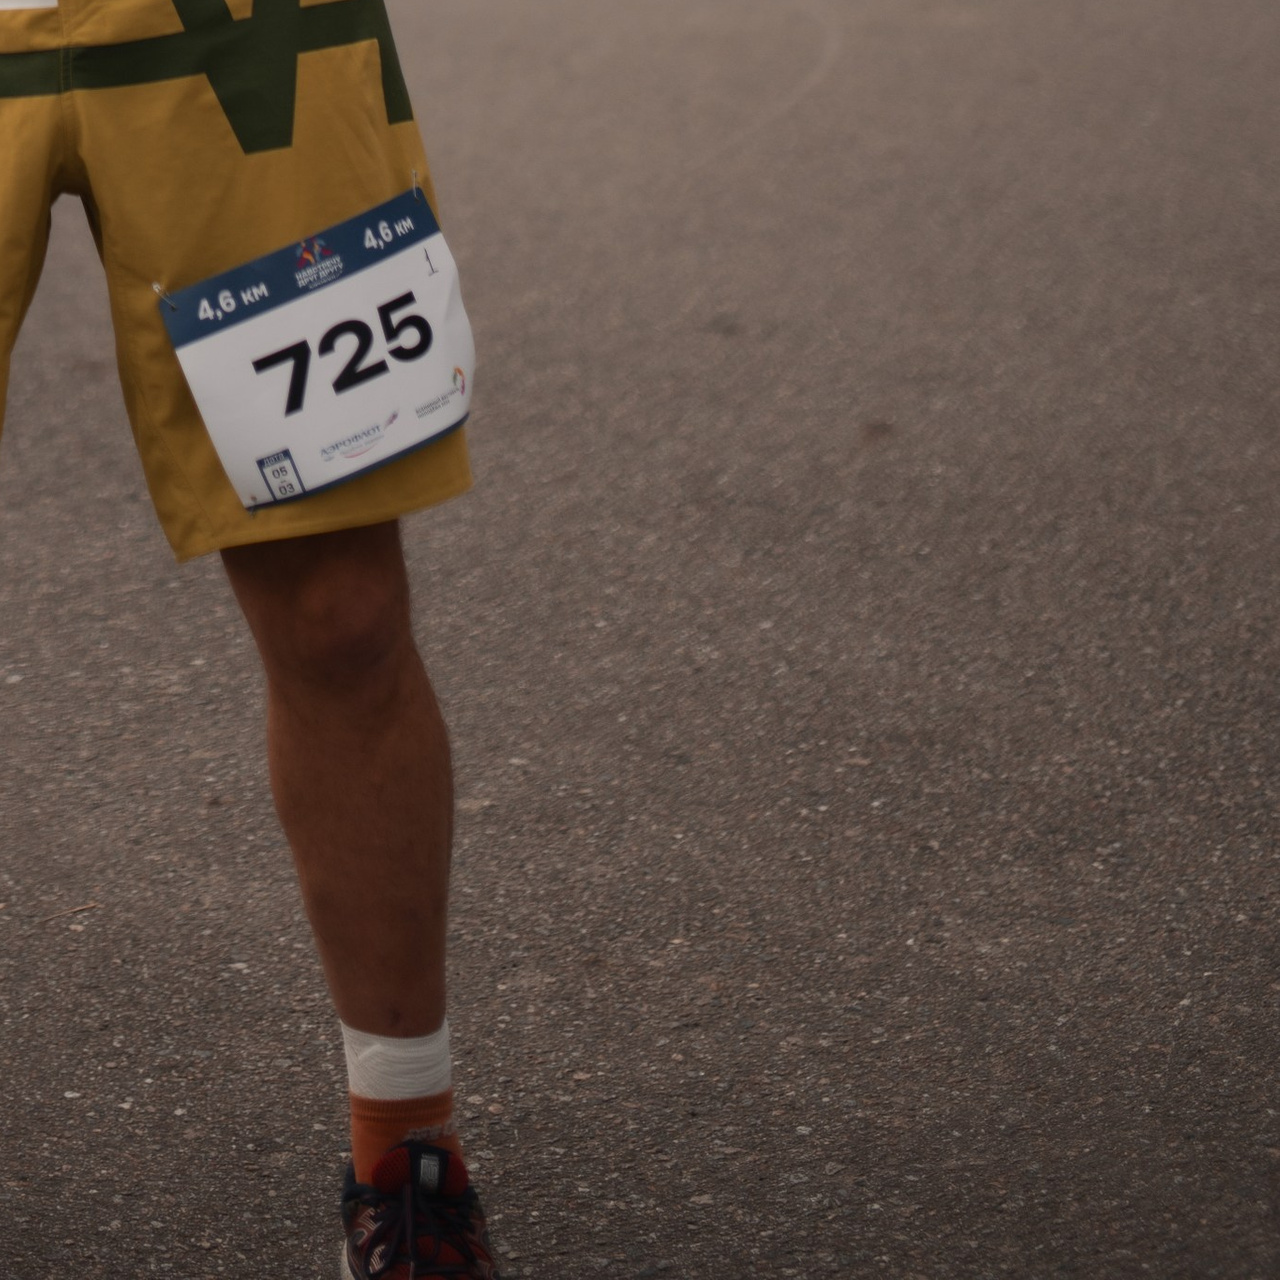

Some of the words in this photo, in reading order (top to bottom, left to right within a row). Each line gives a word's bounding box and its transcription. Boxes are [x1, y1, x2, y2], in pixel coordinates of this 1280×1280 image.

[363, 220, 394, 250] 4,6
[197, 288, 236, 321] 4,6
[252, 290, 433, 418] 725
[320, 424, 382, 458] АЭРОФЛОТ
[272, 465, 288, 479] 05
[279, 483, 295, 496] 03
